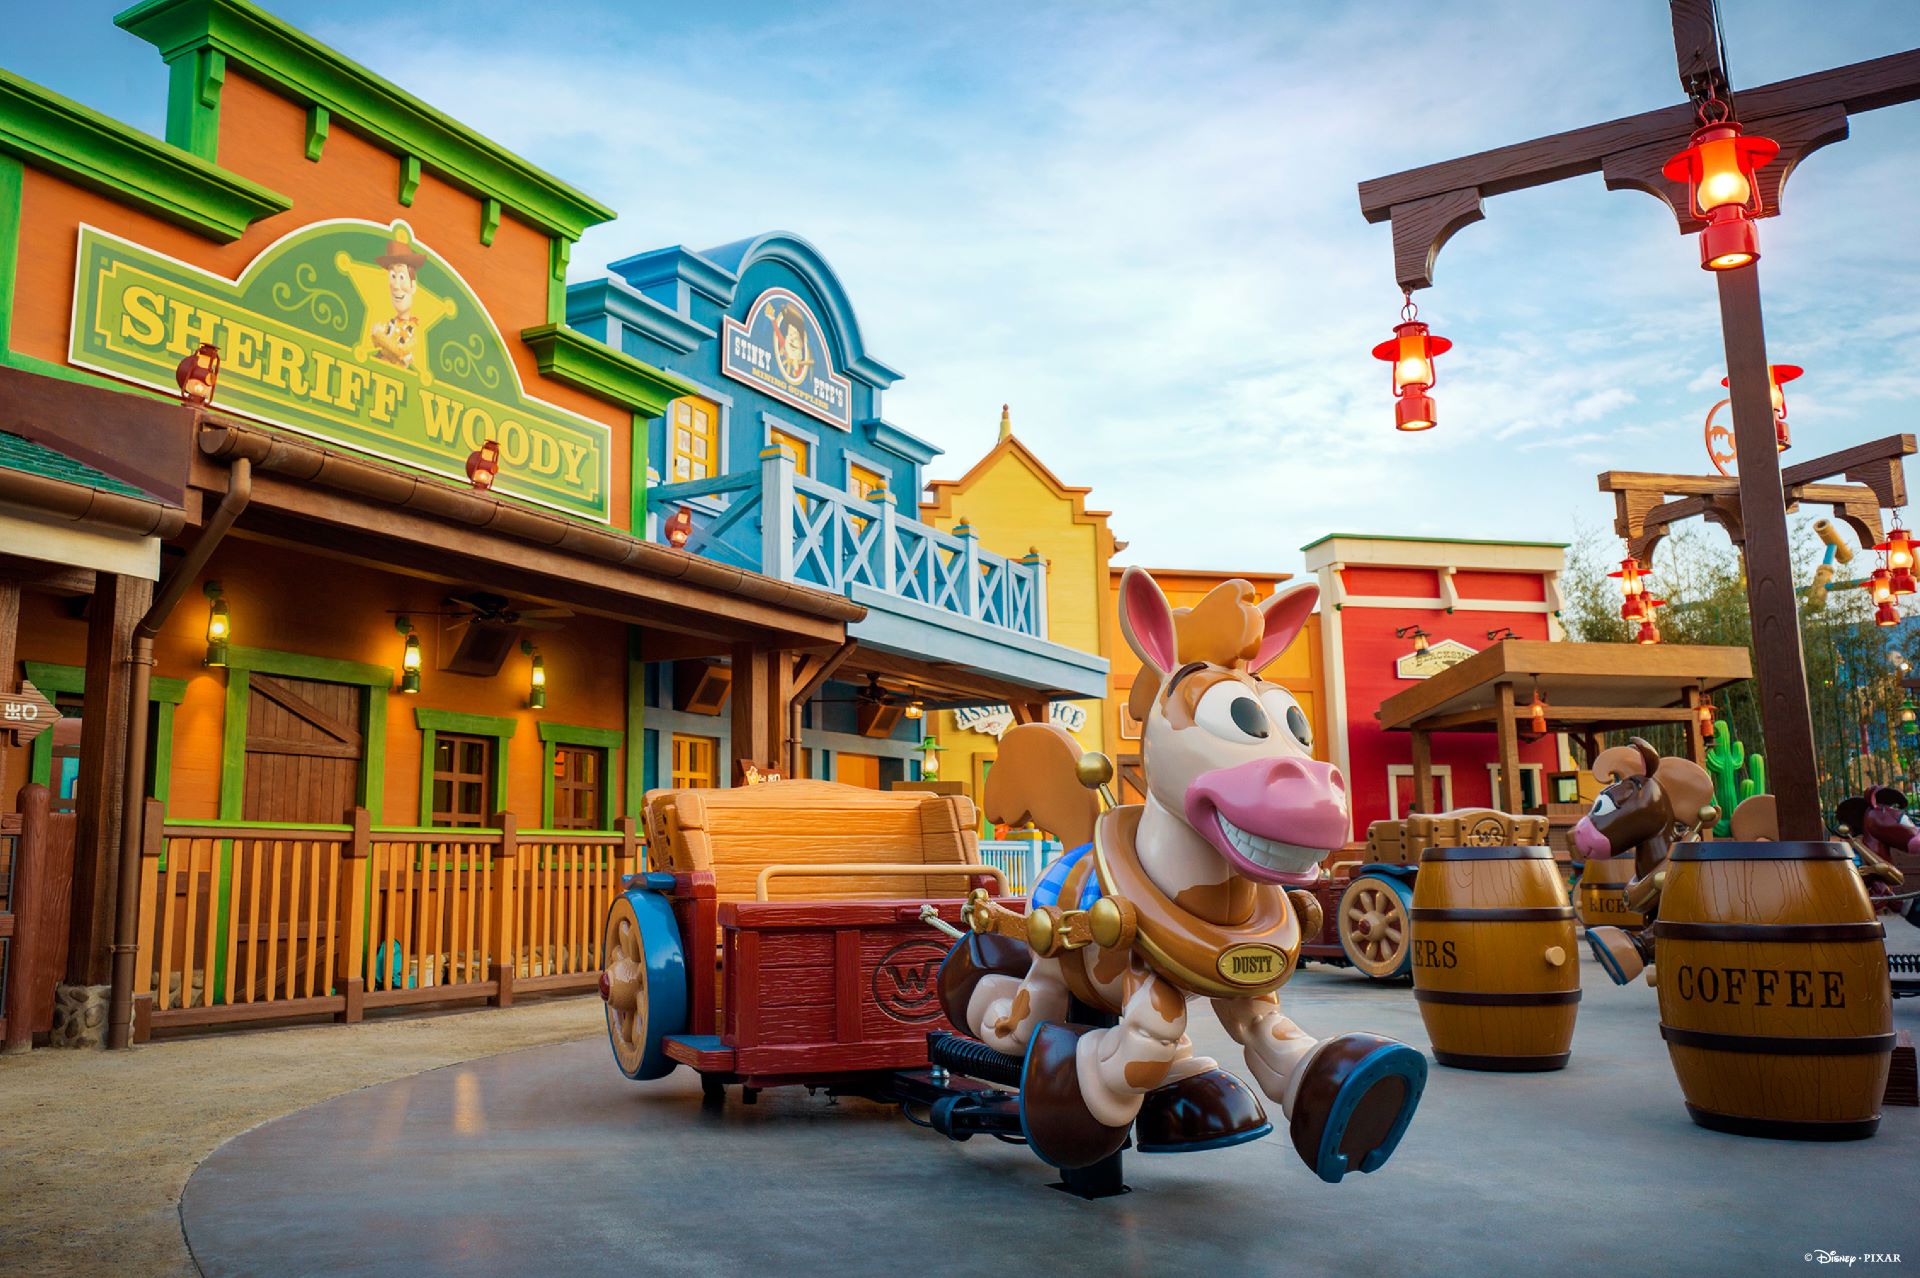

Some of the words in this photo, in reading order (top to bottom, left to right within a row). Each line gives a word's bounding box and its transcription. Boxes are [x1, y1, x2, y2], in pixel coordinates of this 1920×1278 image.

[121, 285, 406, 424] SHERIFF
[418, 388, 588, 486] WOODY
[735, 336, 772, 371] STINKY
[813, 377, 843, 408] PETE'S
[4, 702, 38, 721] 出口
[1232, 955, 1273, 974] DUSTY
[1678, 965, 1846, 1009] COFFEE
